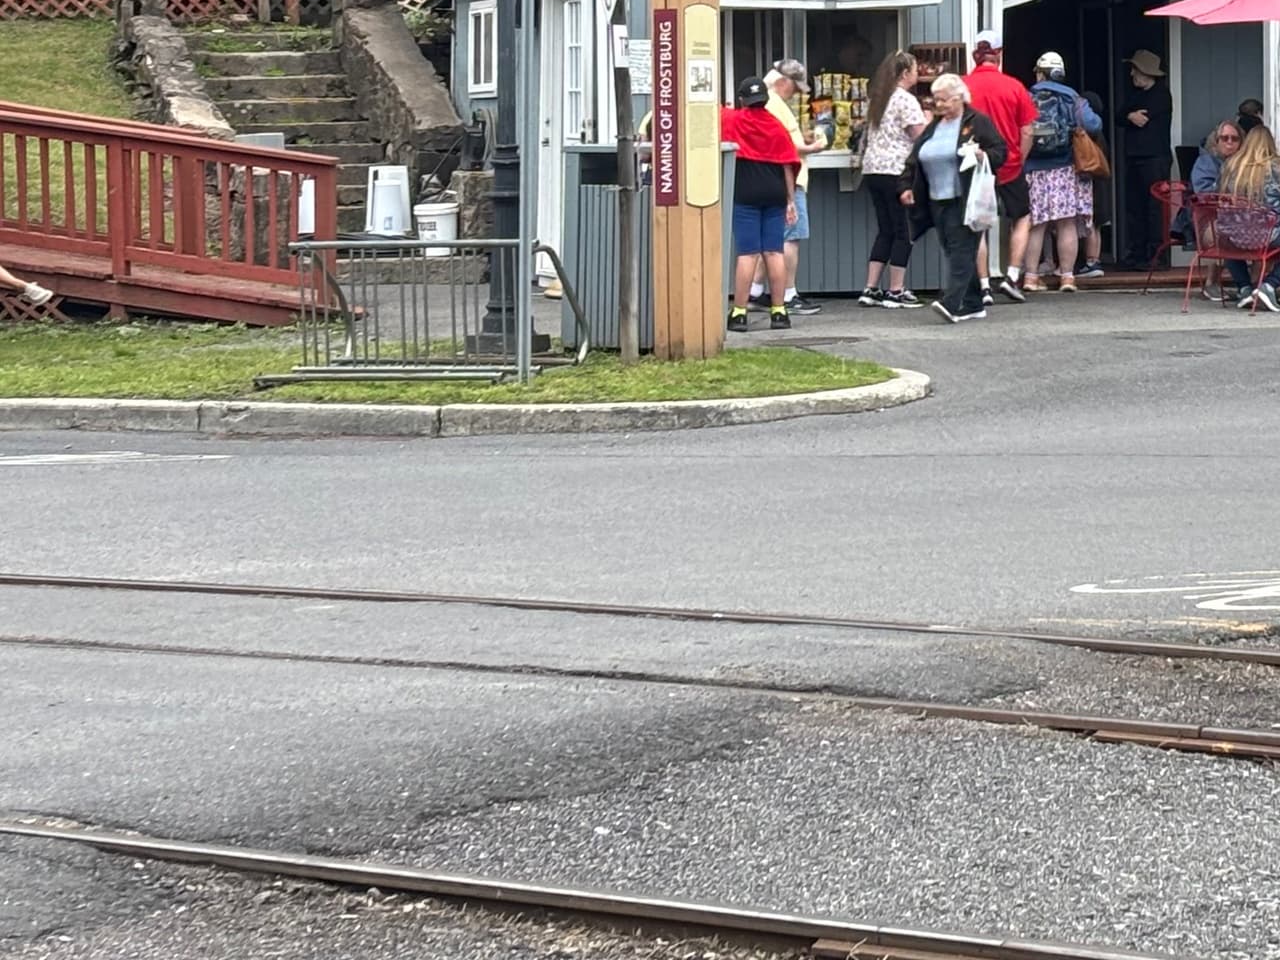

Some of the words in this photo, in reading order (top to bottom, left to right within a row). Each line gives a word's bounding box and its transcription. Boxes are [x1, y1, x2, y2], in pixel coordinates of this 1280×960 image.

[660, 21, 673, 106] FROSTBURG
[660, 110, 673, 130] OF
[660, 133, 673, 193] NAMING
